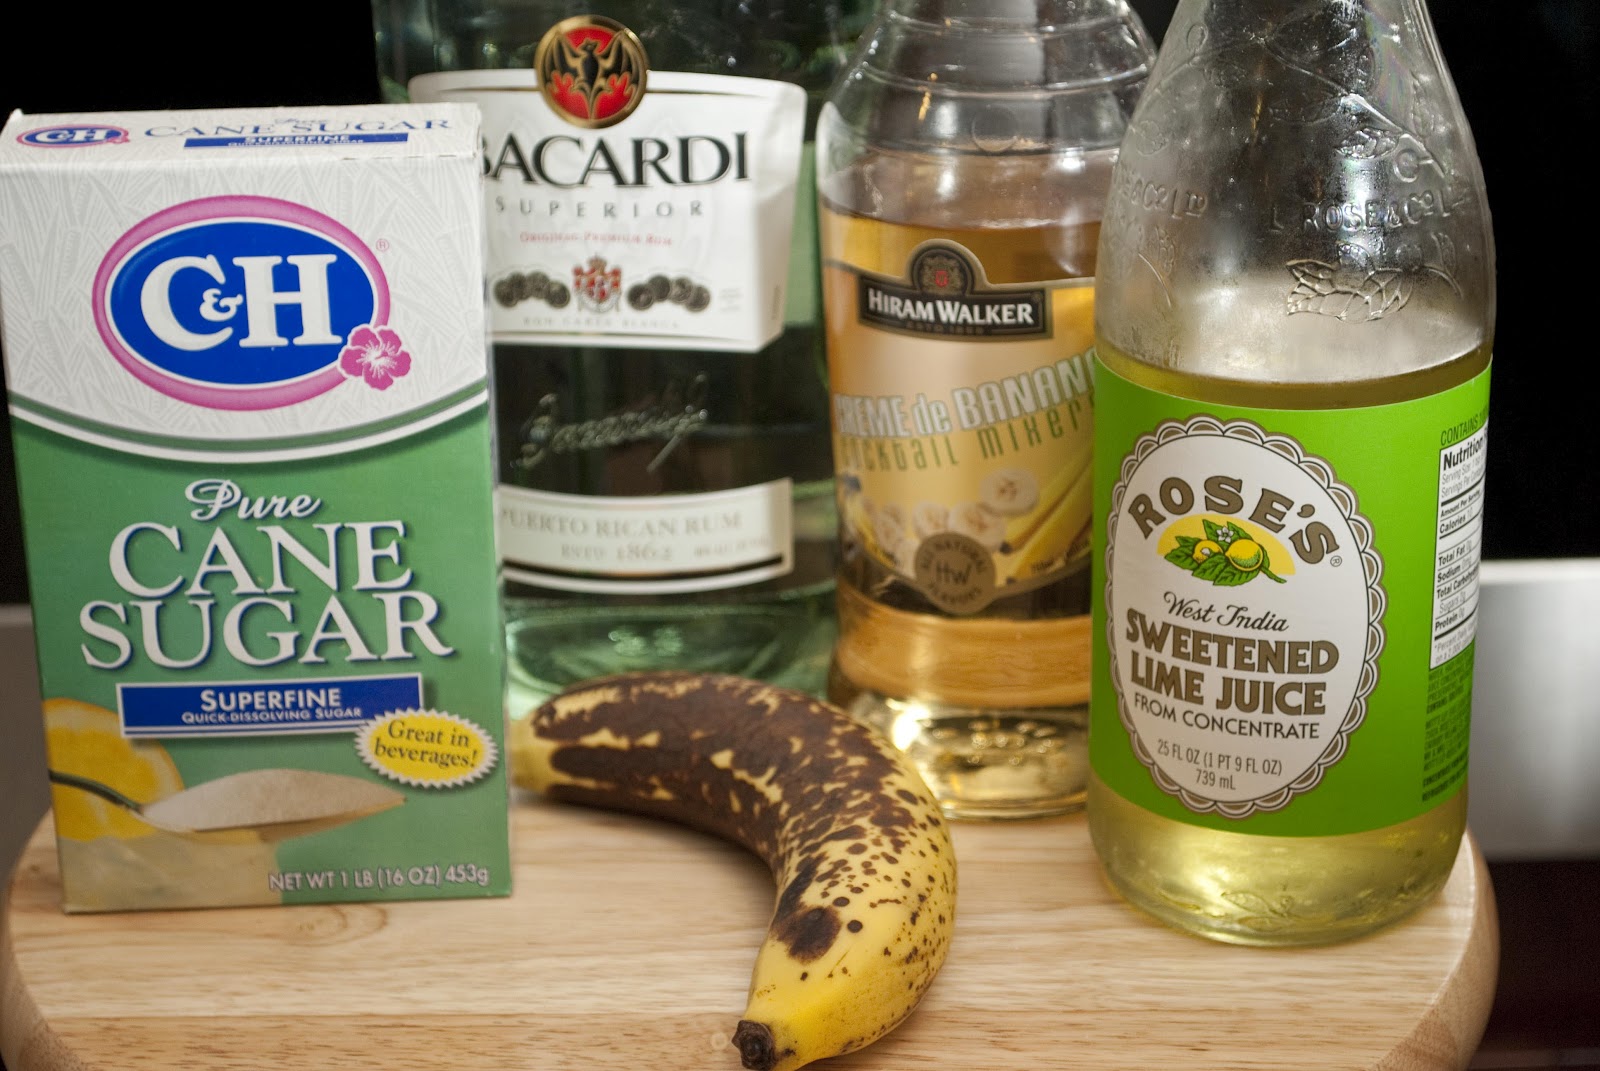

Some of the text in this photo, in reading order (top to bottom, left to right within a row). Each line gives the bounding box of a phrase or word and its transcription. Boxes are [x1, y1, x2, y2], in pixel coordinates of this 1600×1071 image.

[35, 128, 107, 144] C&H
[144, 119, 454, 137] CANE SUGAR
[496, 195, 703, 219] SUPERIOR
[141, 253, 343, 351] C&H
[867, 287, 1035, 326] HIRAM WALKER
[911, 393, 953, 437] de
[184, 478, 322, 522] Pure
[596, 515, 678, 539] RICAN
[685, 510, 743, 536] RUM
[1127, 475, 1340, 565] ROSE'S
[1440, 514, 1466, 534] Calories
[108, 519, 415, 599] CANE
[1438, 549, 1456, 567] Total
[1456, 544, 1466, 558] Fat
[1437, 564, 1461, 583] Sodium
[1436, 583, 1453, 599] Total
[1162, 590, 1291, 633] West India
[1435, 611, 1459, 632] Protein
[79, 591, 454, 670] SUGAR
[1126, 607, 1340, 676] SWEETENED
[1130, 650, 1327, 717] LIME JUICE
[200, 688, 342, 712] SUPERFINE
[181, 707, 362, 724] QUICK-DISSOLVING SUGAR
[1134, 691, 1321, 740] FROM CONCENTRATE
[387, 718, 470, 748] Great in
[373, 736, 478, 770] beverages!
[1157, 738, 1283, 777] 25 FL OZ (1 PT 9 FL OZ)
[1196, 767, 1237, 791] 739 mL
[268, 863, 490, 892] NET WT 1 LB (16 OZ) 453g
